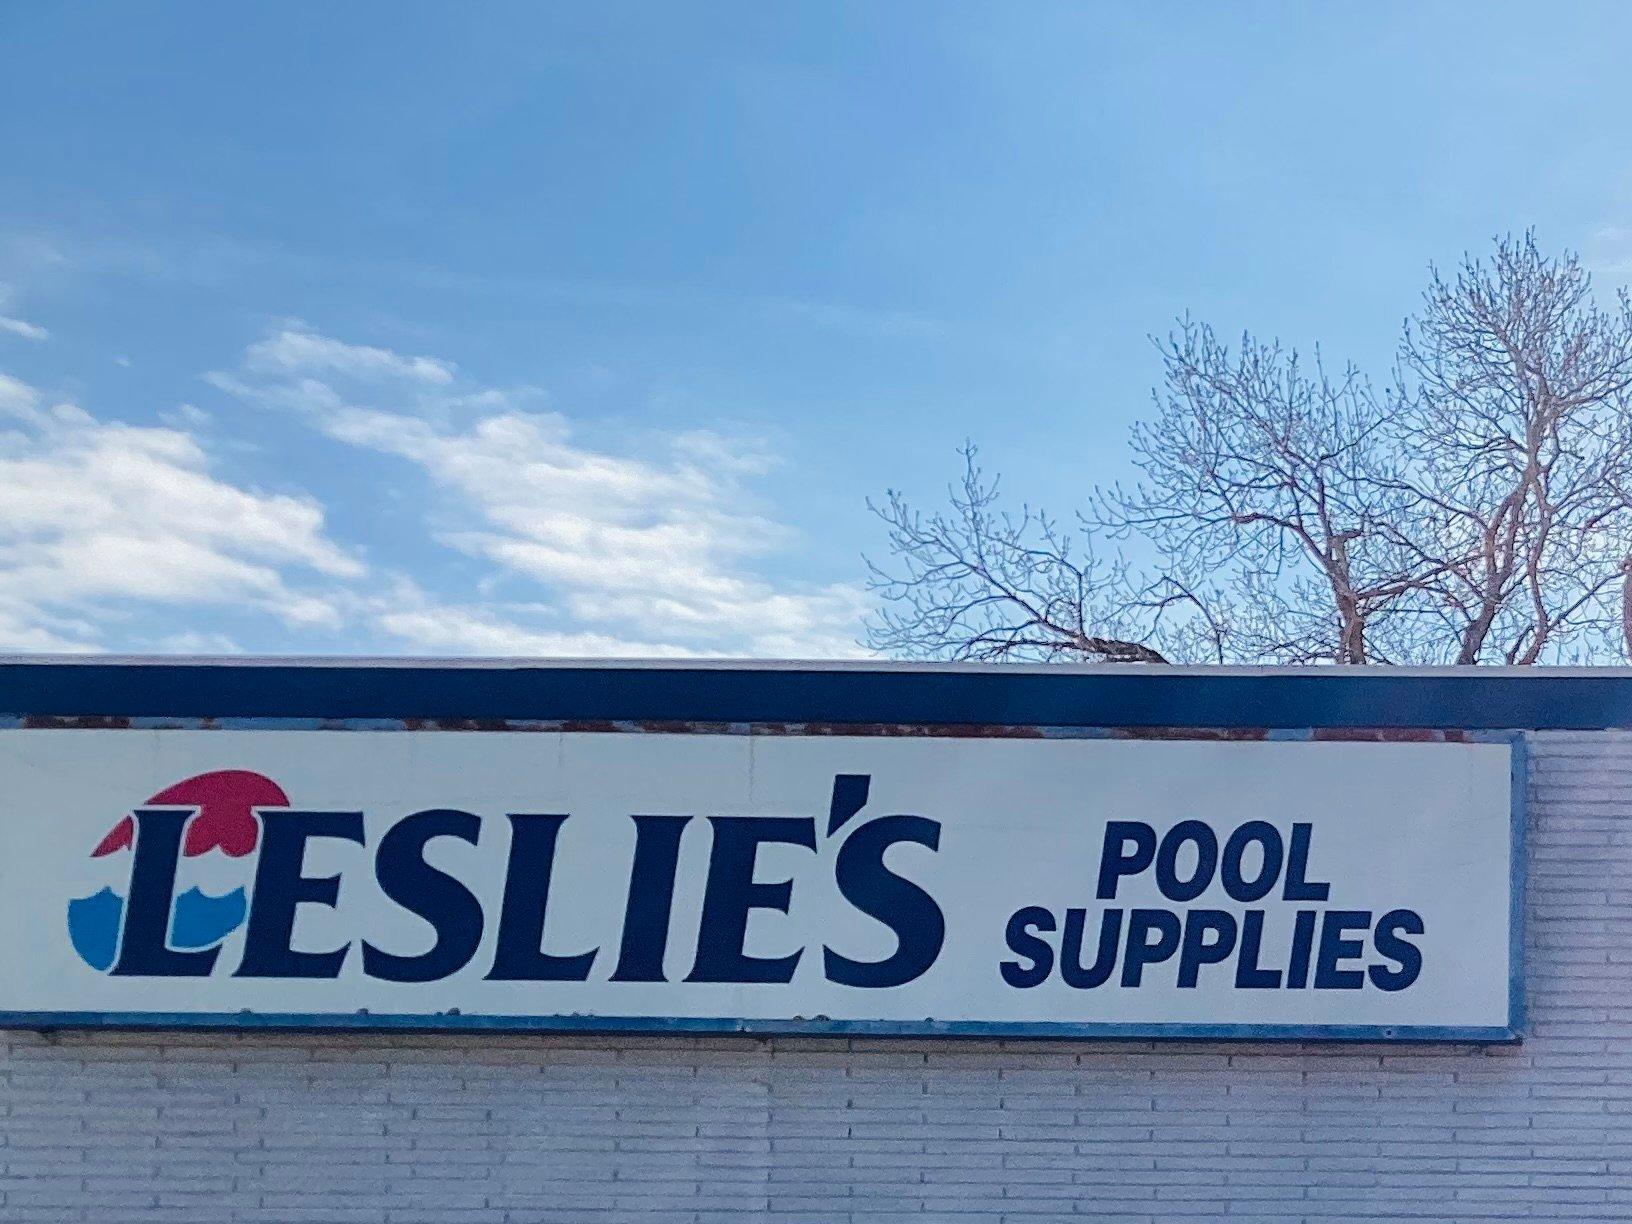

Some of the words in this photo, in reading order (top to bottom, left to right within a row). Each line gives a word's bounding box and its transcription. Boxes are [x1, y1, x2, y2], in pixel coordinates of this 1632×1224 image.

[107, 774, 945, 989] LESLIE'S
[1096, 819, 1331, 902] POOL
[1000, 906, 1425, 992] SUPPLIES
